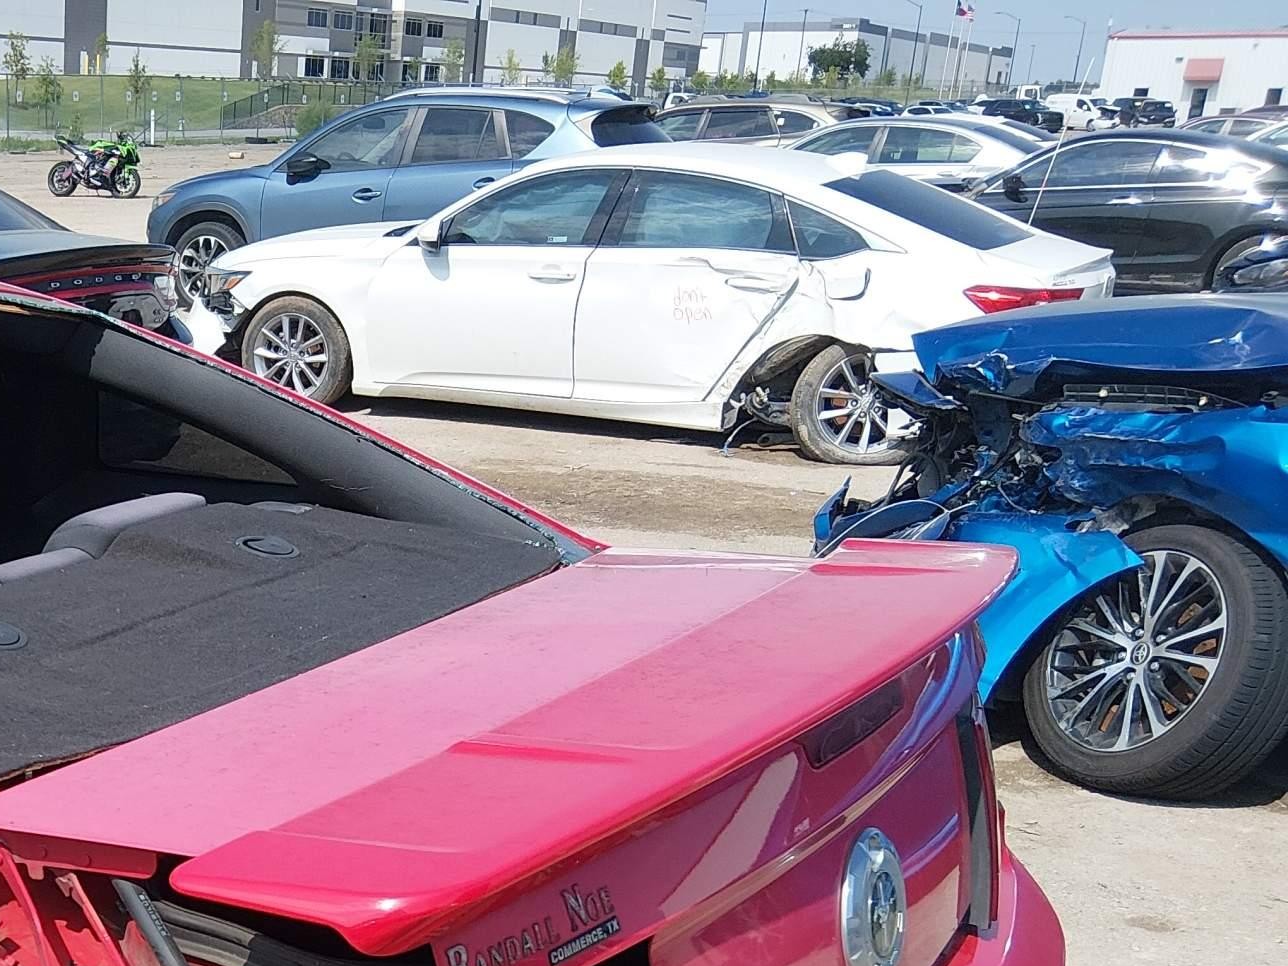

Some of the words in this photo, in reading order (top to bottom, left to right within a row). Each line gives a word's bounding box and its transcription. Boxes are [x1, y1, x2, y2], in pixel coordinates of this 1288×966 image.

[50, 273, 142, 289] DODGE
[672, 306, 713, 326] open
[549, 929, 608, 965] COMMERCE,
[605, 917, 621, 938] TX
